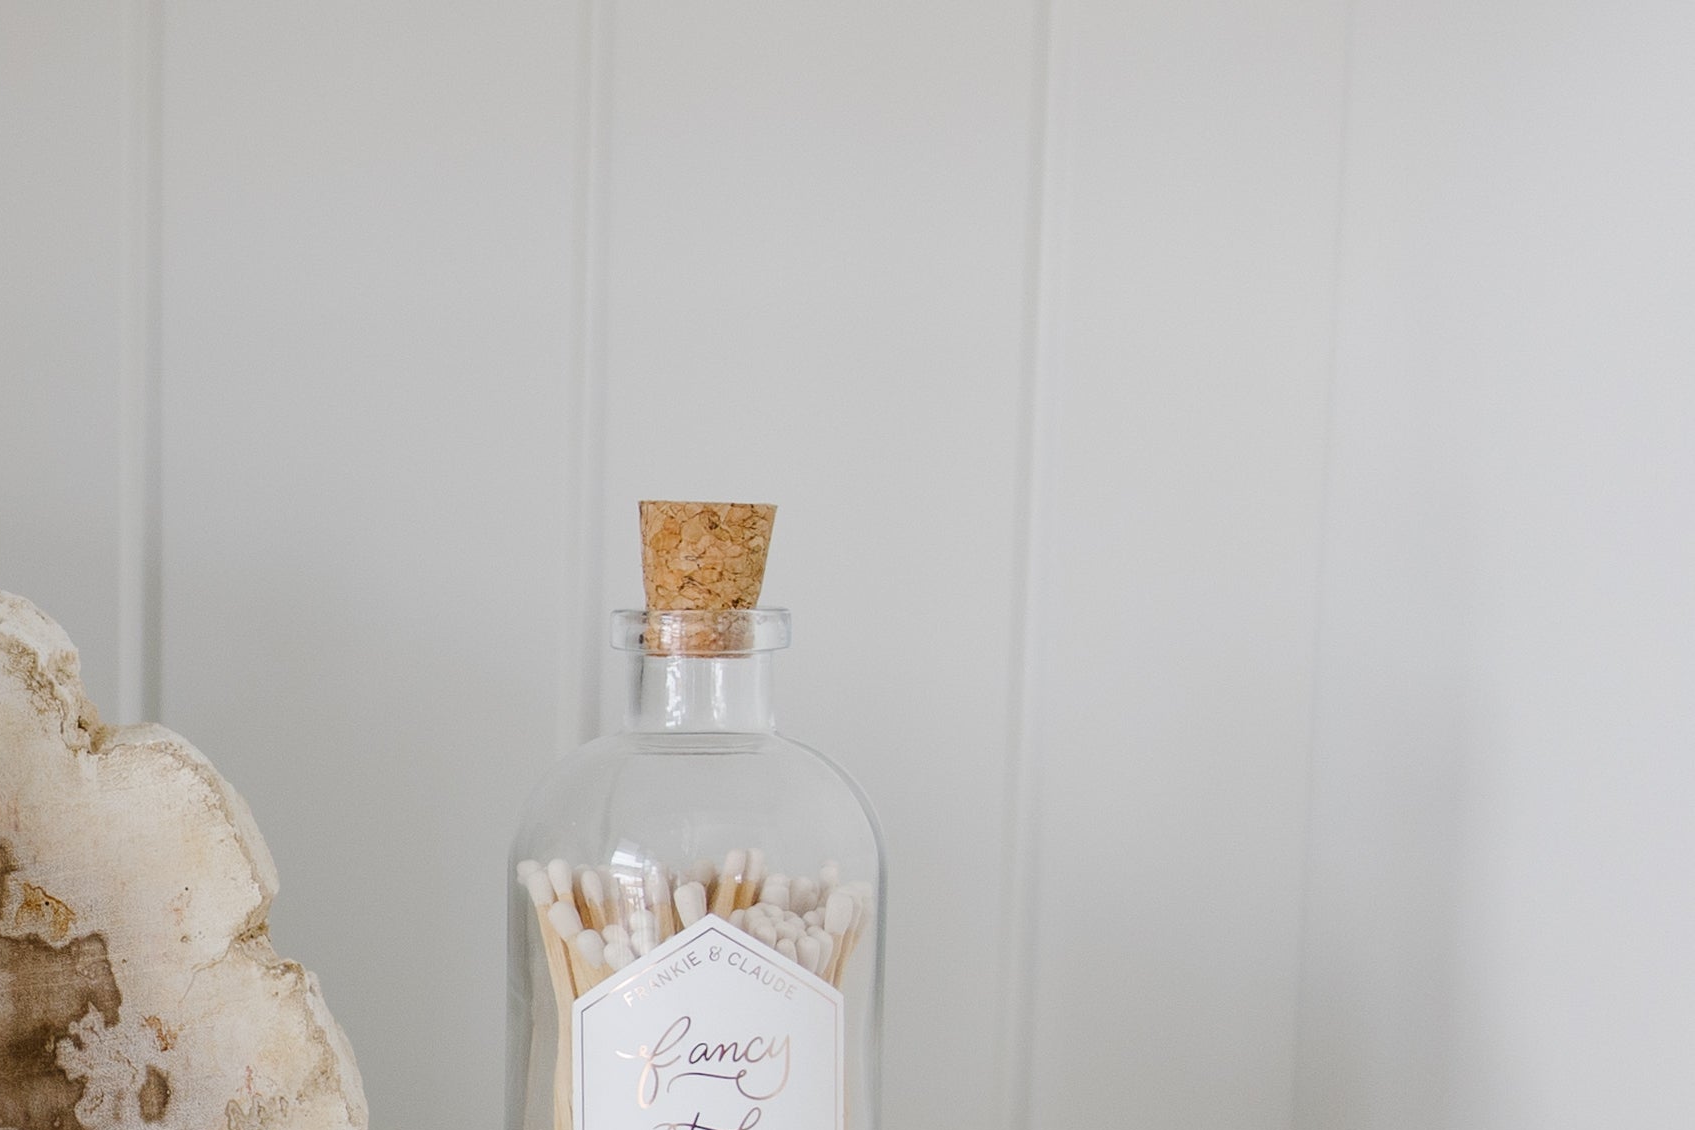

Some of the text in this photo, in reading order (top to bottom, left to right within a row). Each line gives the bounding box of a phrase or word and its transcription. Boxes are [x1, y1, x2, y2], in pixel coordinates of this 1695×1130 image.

[623, 945, 798, 1008] FRANKIE & CLAUDE
[615, 1015, 791, 1109] fancy
